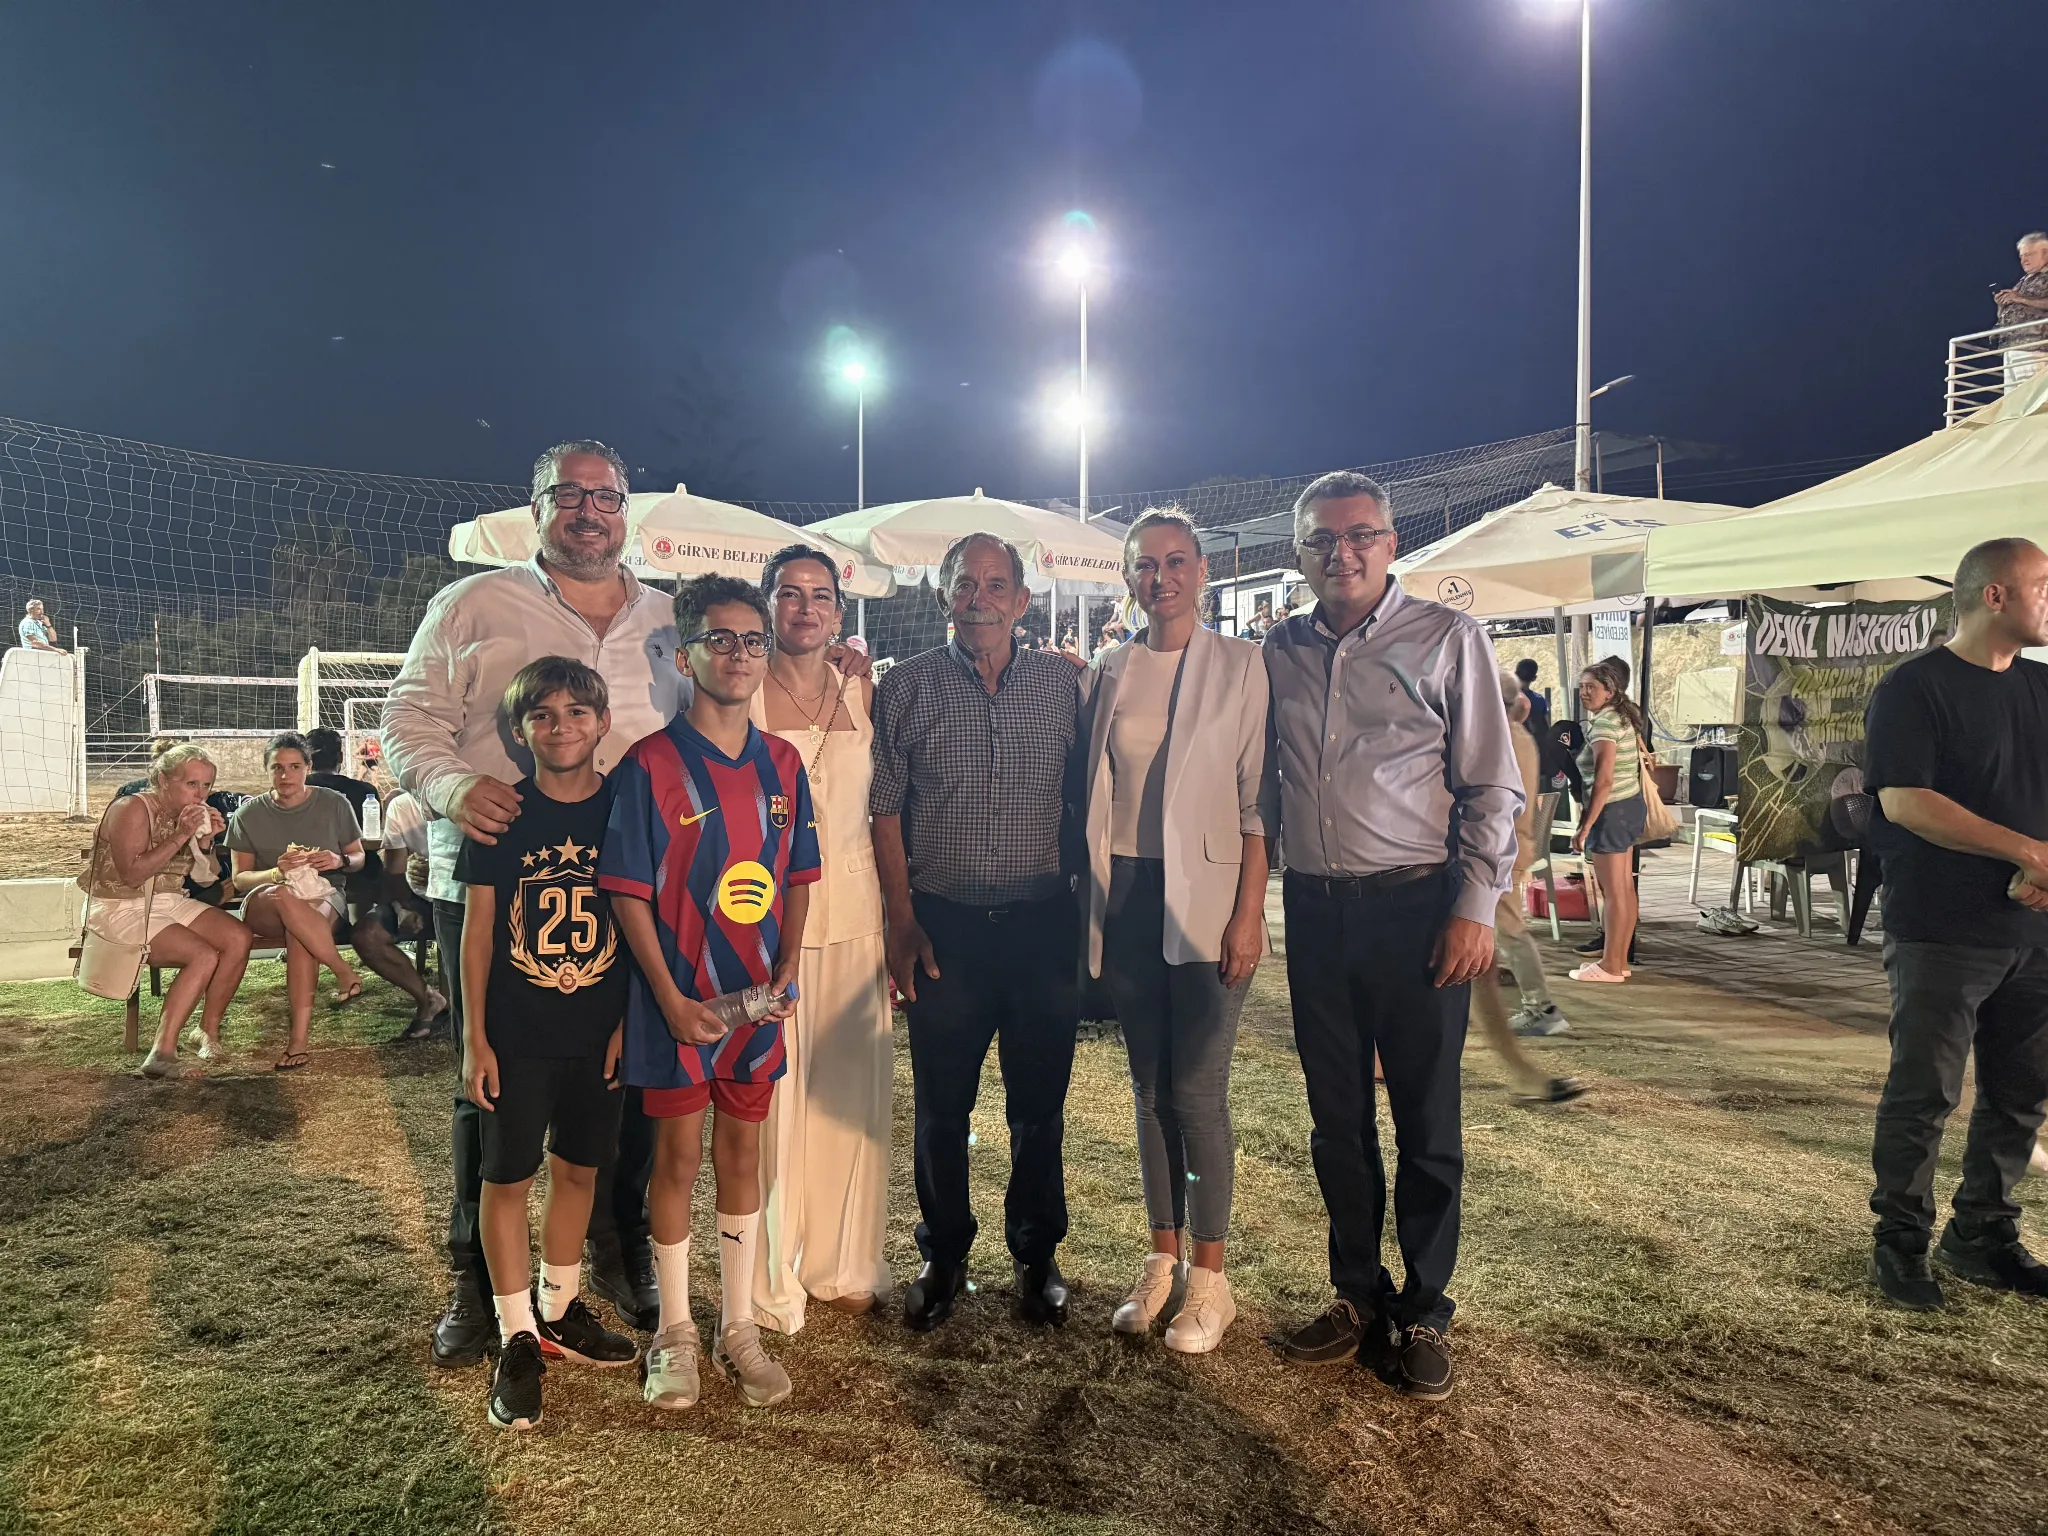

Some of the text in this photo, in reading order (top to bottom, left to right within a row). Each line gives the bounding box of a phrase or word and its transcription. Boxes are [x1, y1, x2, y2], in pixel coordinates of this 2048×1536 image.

[1553, 519, 1667, 539] EFES
[677, 542, 720, 560] GİRNE
[1055, 553, 1080, 567] GİRNE
[1081, 558, 1119, 571] BELEDİY
[1755, 609, 1820, 658] DENİZ
[538, 886, 597, 955] 25
